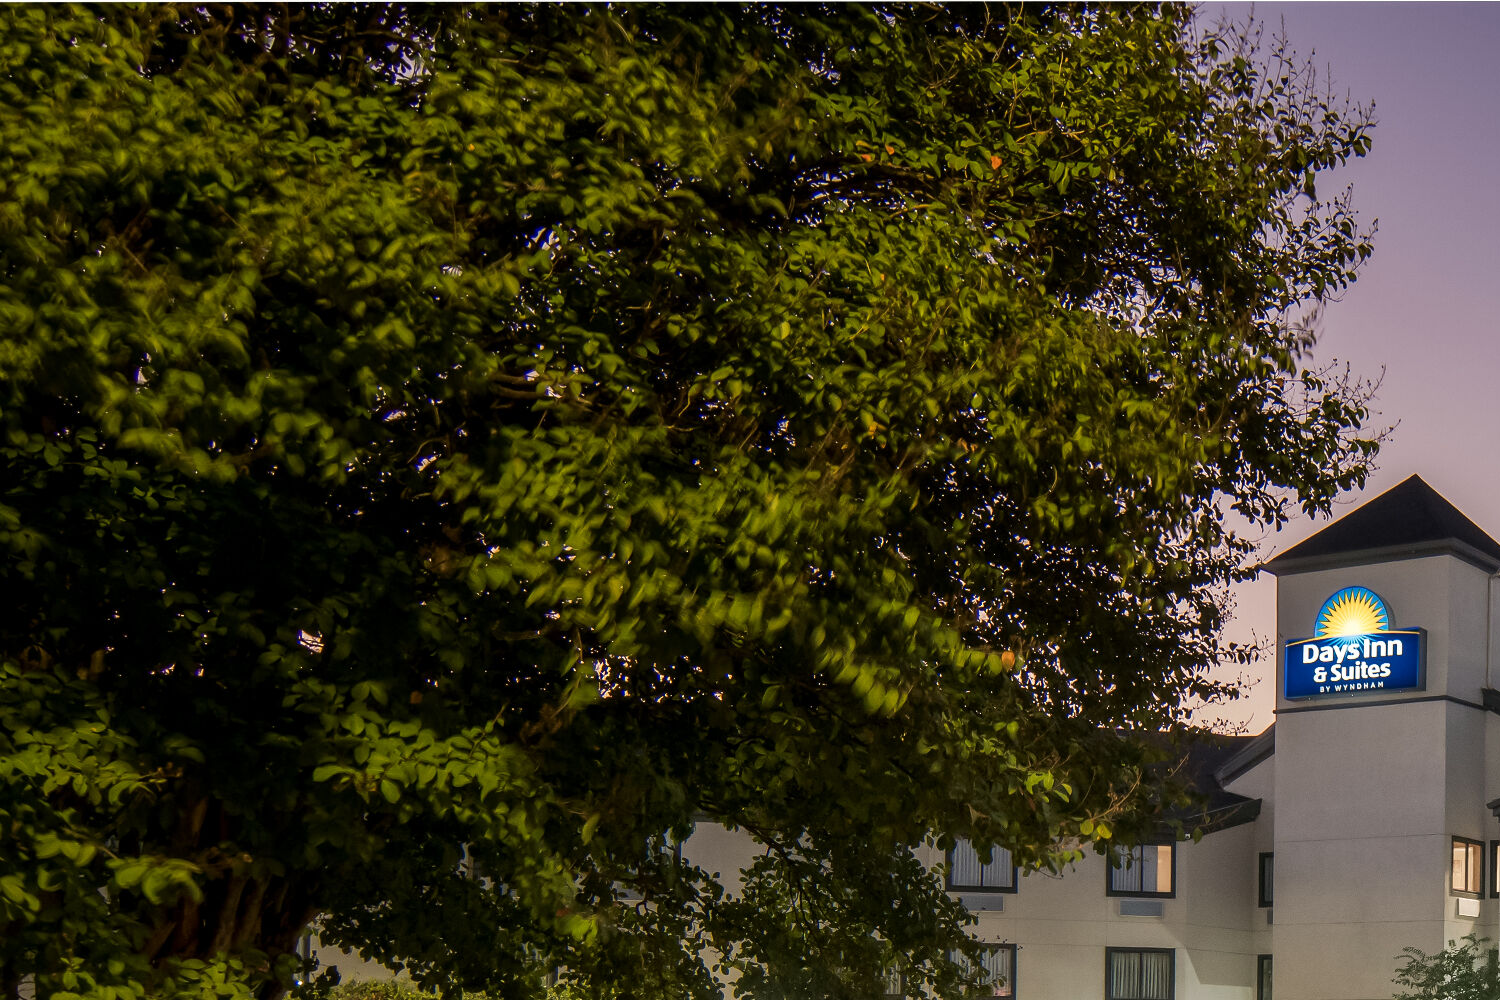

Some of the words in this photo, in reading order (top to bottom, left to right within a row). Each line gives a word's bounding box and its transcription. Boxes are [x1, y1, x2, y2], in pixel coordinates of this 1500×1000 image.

[1303, 643, 1360, 664] Days
[1363, 639, 1403, 658] Inn
[1313, 667, 1327, 682] &
[1330, 661, 1391, 682] Suites
[1335, 681, 1384, 692] WYNDHAM
